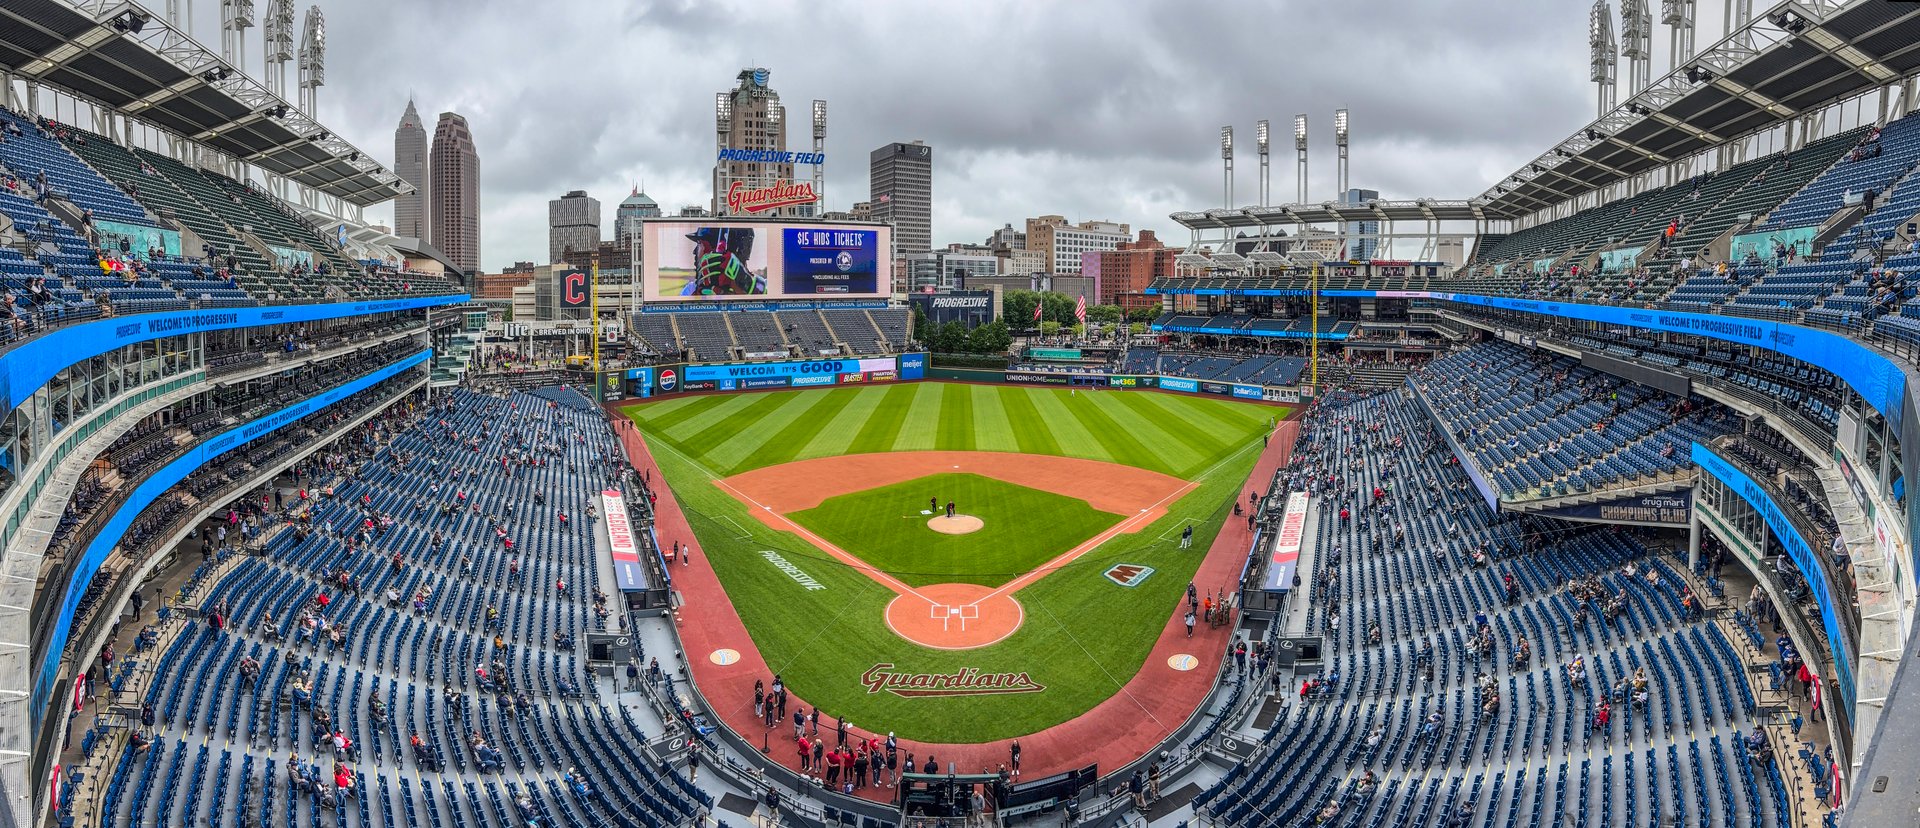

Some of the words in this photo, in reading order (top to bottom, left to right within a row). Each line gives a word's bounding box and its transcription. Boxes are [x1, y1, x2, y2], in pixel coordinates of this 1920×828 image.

[718, 148, 793, 163] PROGRESSIVE
[794, 152, 825, 165] FIELD
[727, 179, 818, 214] Guardians
[798, 231, 809, 245] $15
[814, 232, 830, 246] KIDS
[565, 273, 585, 305] C
[932, 297, 989, 308] PROGRESSIVE
[115, 322, 141, 339] PROGRESSIVE
[148, 316, 182, 333] WELCOME
[183, 316, 191, 328] TO
[191, 313, 238, 327] PROGRESSIVE
[503, 322, 528, 340] Lite
[1659, 315, 1690, 328] WELCOME
[1691, 318, 1700, 330] TO
[1701, 318, 1742, 338] PROGRESSIVE
[1743, 325, 1762, 340] FIELD
[1768, 329, 1796, 347] PROGRESSIVE
[729, 367, 775, 376] WELCOM
[801, 361, 843, 373] GOOD
[903, 360, 922, 369] meijer
[608, 377, 618, 386] 811
[792, 375, 833, 384] PROGRESSIVE
[844, 373, 863, 383] BLASTER
[1160, 380, 1195, 390] PROGRESSIVE
[242, 421, 271, 439] WELCOME
[272, 418, 278, 427] TO
[279, 403, 310, 424] PROGRESSIVE
[1642, 498, 1662, 508] drug
[1663, 499, 1685, 507] mart
[1601, 506, 1657, 521] CHAMPIONS
[1660, 508, 1686, 523] CLUB
[1708, 457, 1733, 481] PROGRESSIVE
[1744, 482, 1767, 511] HOME
[1767, 504, 1789, 541] SWEET
[1789, 532, 1812, 574] HOME
[608, 513, 632, 548] CLEVELAND
[1280, 512, 1304, 547] GUARDIANS
[758, 550, 827, 592] PROGRESSIVE
[860, 663, 1047, 699] Guardians
